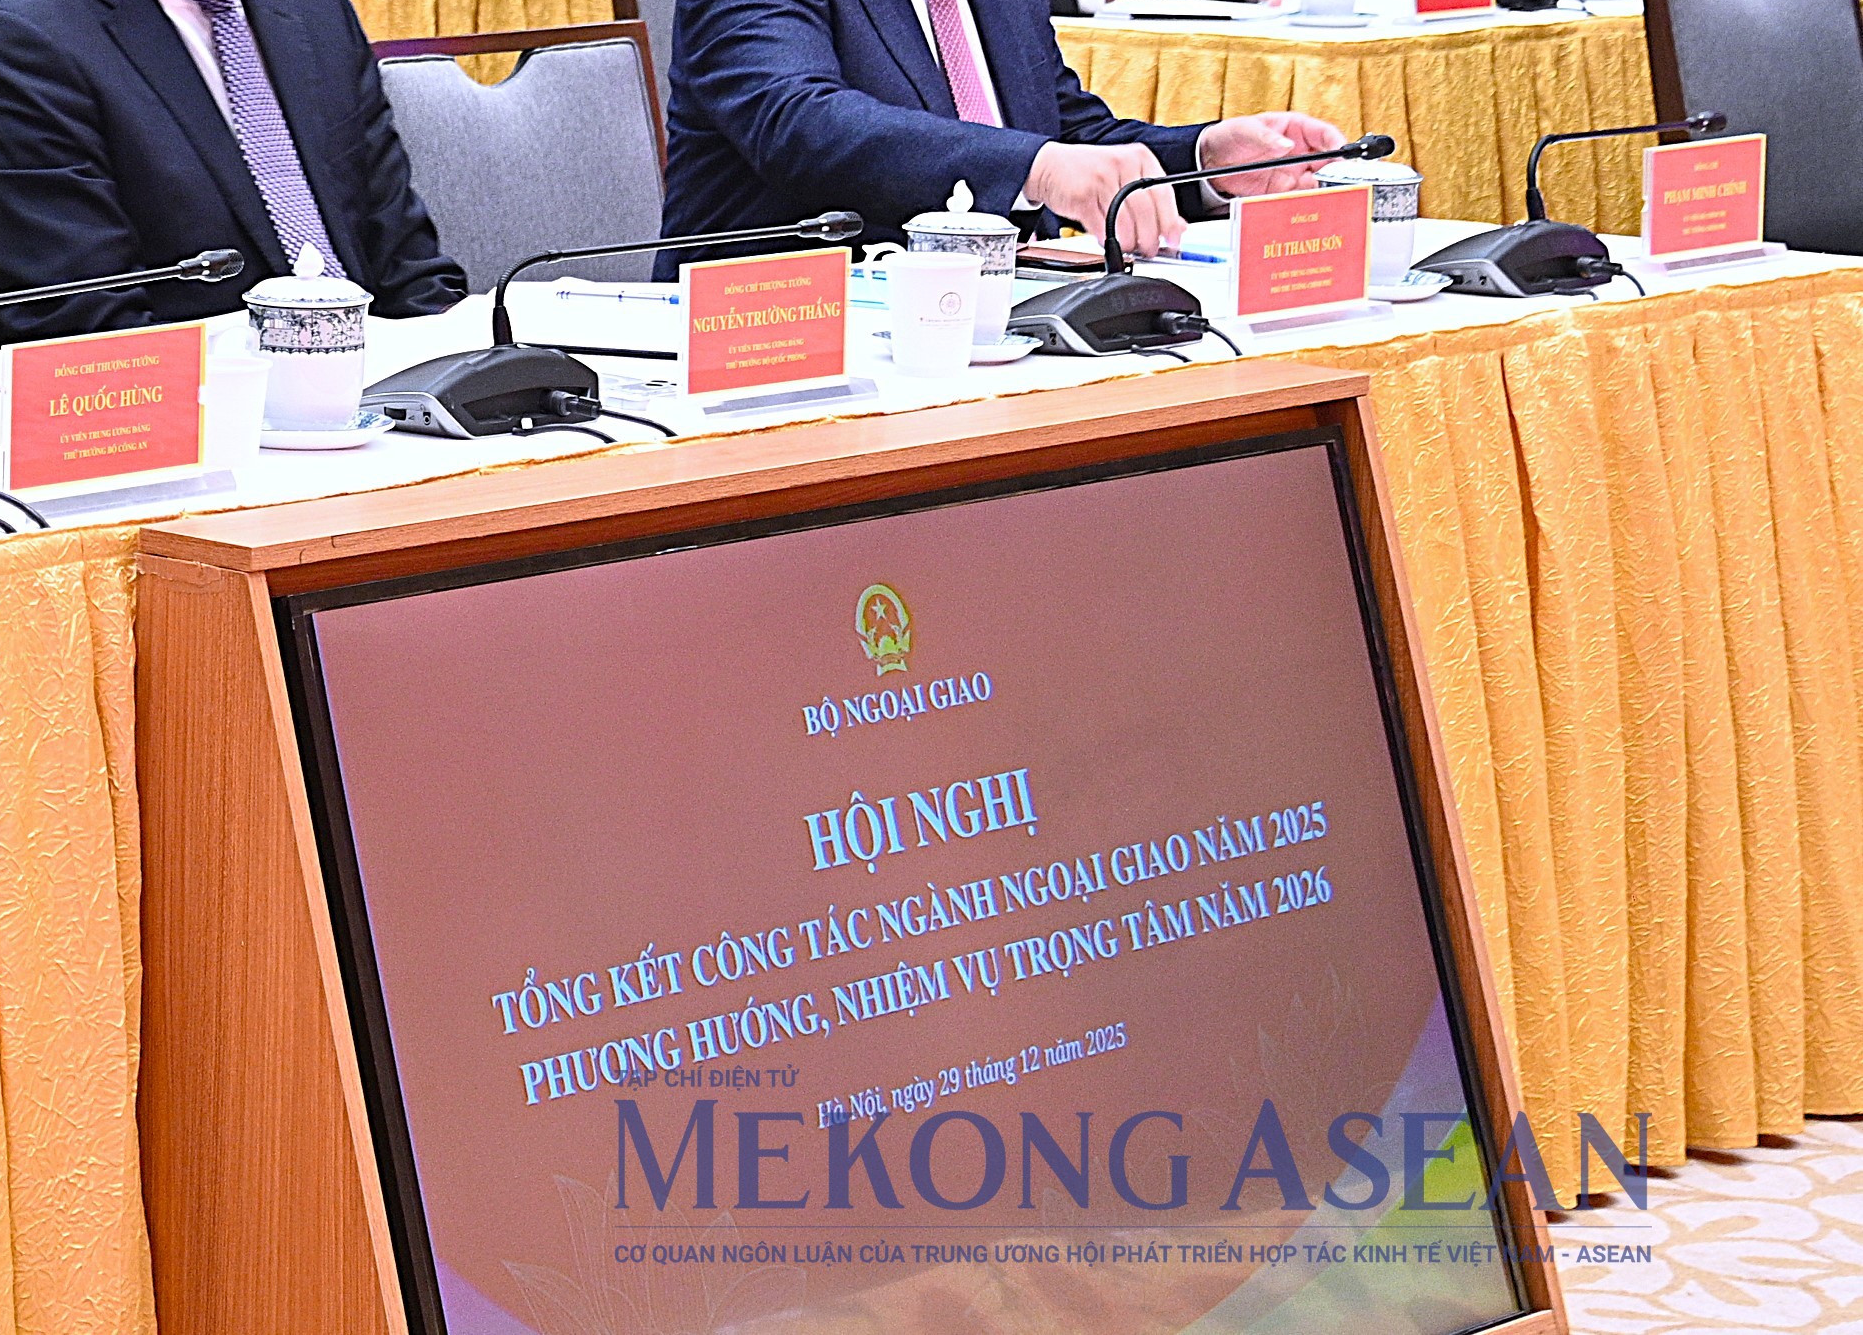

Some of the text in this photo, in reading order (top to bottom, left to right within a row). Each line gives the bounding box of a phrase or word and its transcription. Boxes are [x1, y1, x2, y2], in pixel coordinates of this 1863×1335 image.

[1263, 234, 1343, 259] BÙI THANH SƠN
[693, 296, 841, 334] NGUYỄN TRƯỜNG THẮNG
[54, 355, 160, 378] ĐỒNG CHÍ THƯỢNG TƯỚNG
[49, 384, 163, 417] LÊ QUỐC HÙNG
[802, 672, 993, 737] BỘ NGOẠI GIAO
[804, 768, 1038, 874] HỘI NGHỊ
[491, 800, 1328, 1035] TỔNG KẾT CÔNG TÁC NGÀNH NGOẠI GIAO NĂM 2025
[519, 866, 1333, 1105] PHƯƠNG HƯỚNG, NHIỆM VỤ TRỌNG TÂM NĂM 2026
[816, 1022, 1128, 1129] Hà Nội, ngày 29 tháng 12 năm 2025
